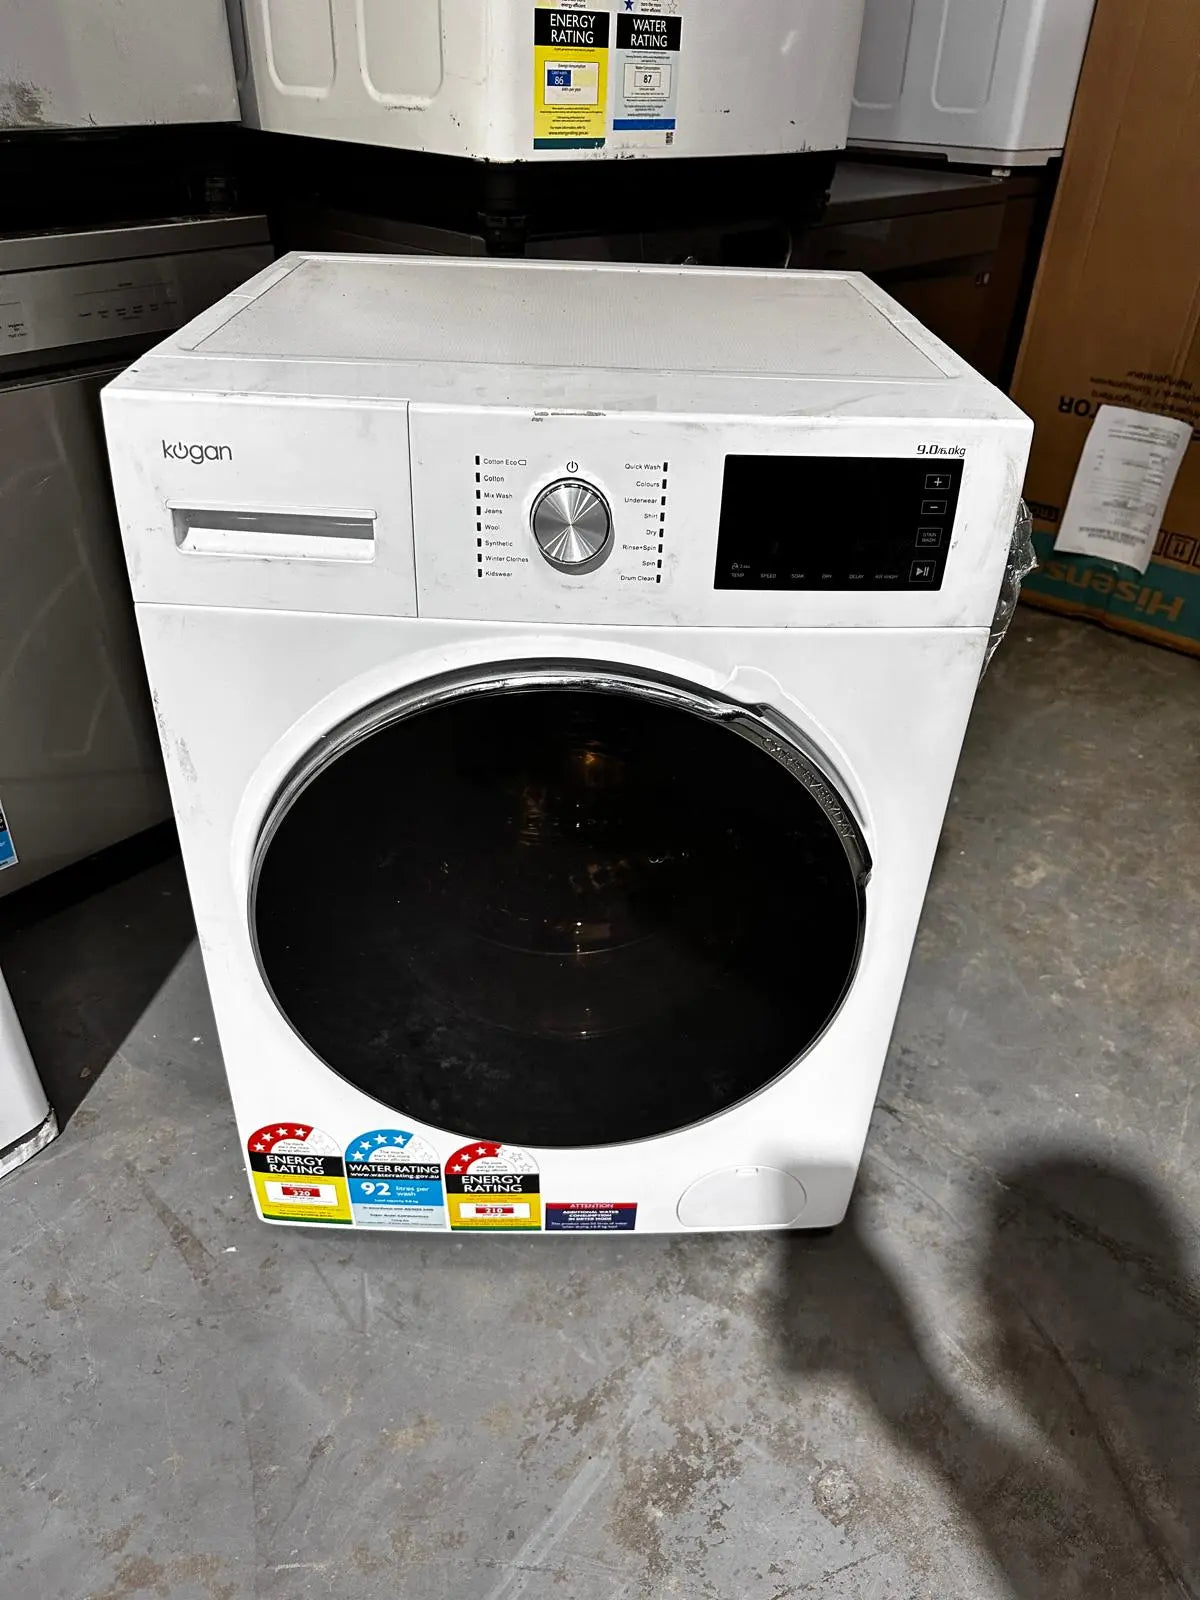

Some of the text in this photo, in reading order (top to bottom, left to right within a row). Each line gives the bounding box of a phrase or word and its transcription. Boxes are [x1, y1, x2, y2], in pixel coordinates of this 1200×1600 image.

[550, 14, 596, 28] ENERGY
[633, 18, 667, 32] WATER
[551, 30, 594, 44] RATING
[630, 34, 667, 47] RATING
[554, 76, 563, 85] 86
[644, 75, 652, 83] 87
[162, 439, 232, 464] kogan
[1037, 561, 1184, 622] Hisens
[266, 1155, 325, 1166] ENERGY
[269, 1164, 325, 1175] RATING
[349, 1164, 439, 1174] WATER RATING
[462, 1175, 524, 1184] ENERGY
[361, 1182, 391, 1196] 92
[464, 1184, 522, 1192] RATING
